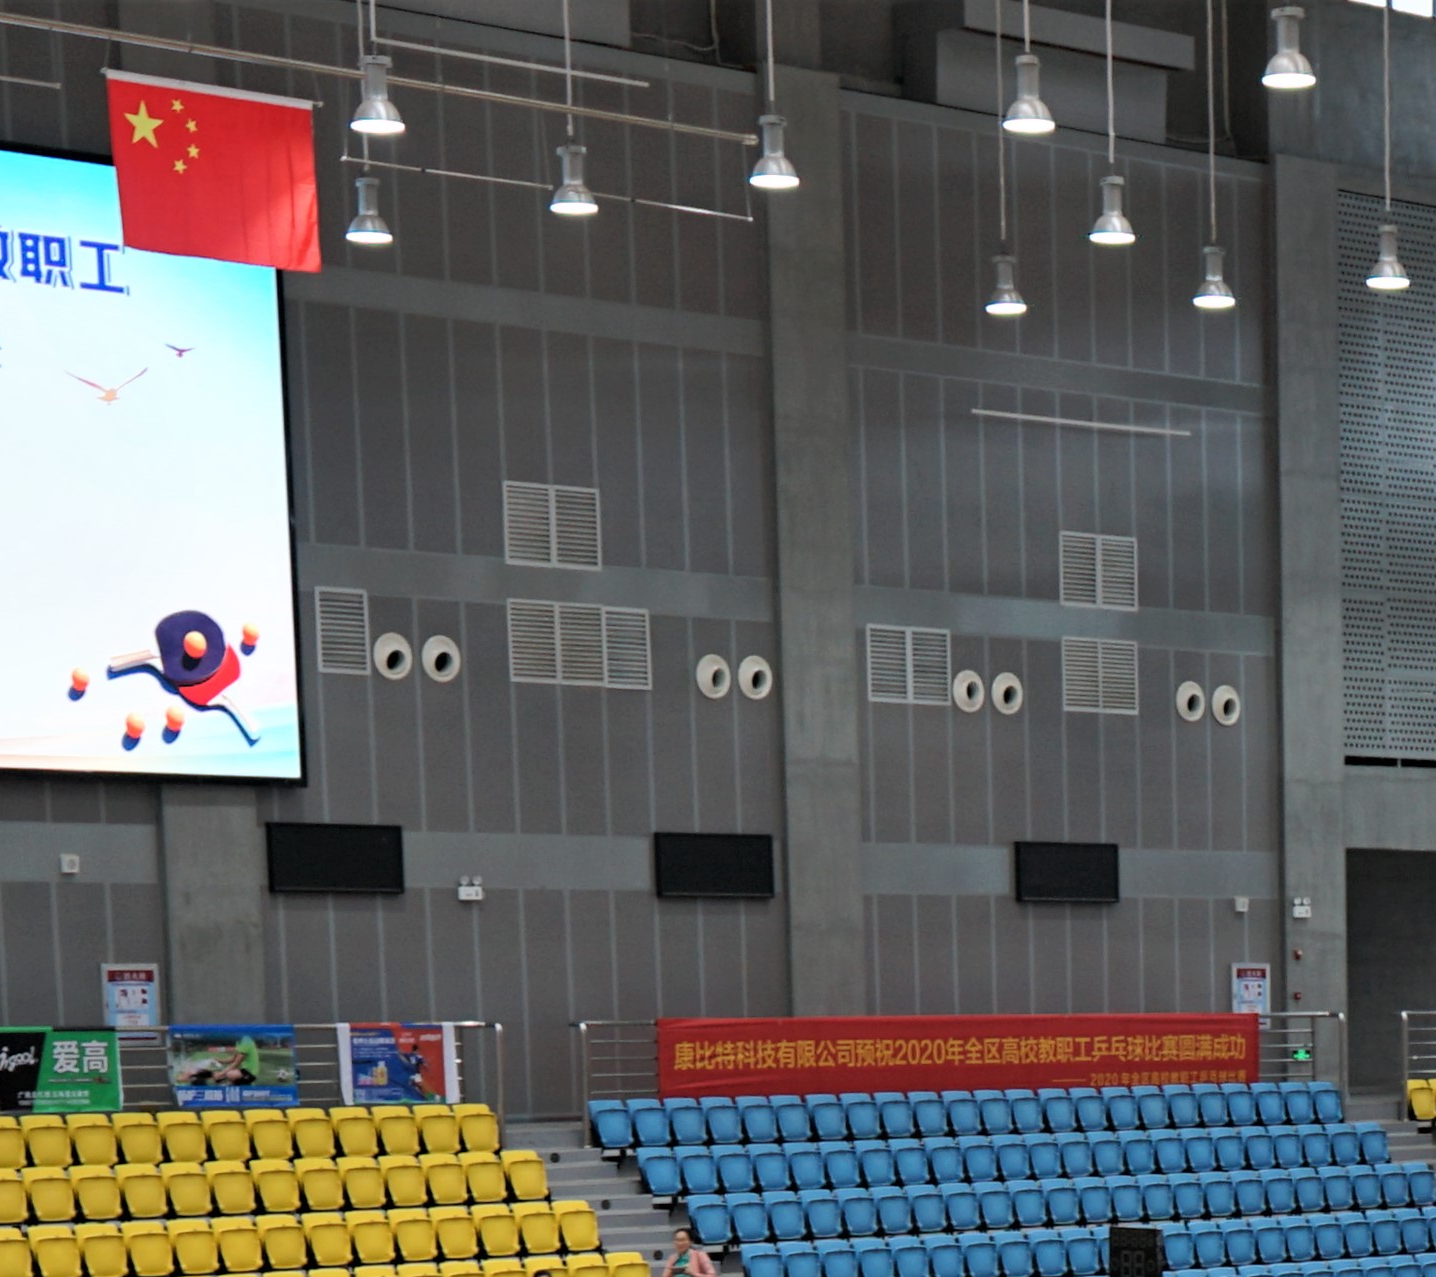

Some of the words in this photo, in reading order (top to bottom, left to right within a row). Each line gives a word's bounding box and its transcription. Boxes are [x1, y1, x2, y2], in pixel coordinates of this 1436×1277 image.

[52, 1040, 109, 1073] 爱高
[674, 1034, 1246, 1070] 康比特科技有限公司预祝2020年全区高校教职工乒乓球比赛圆满成功
